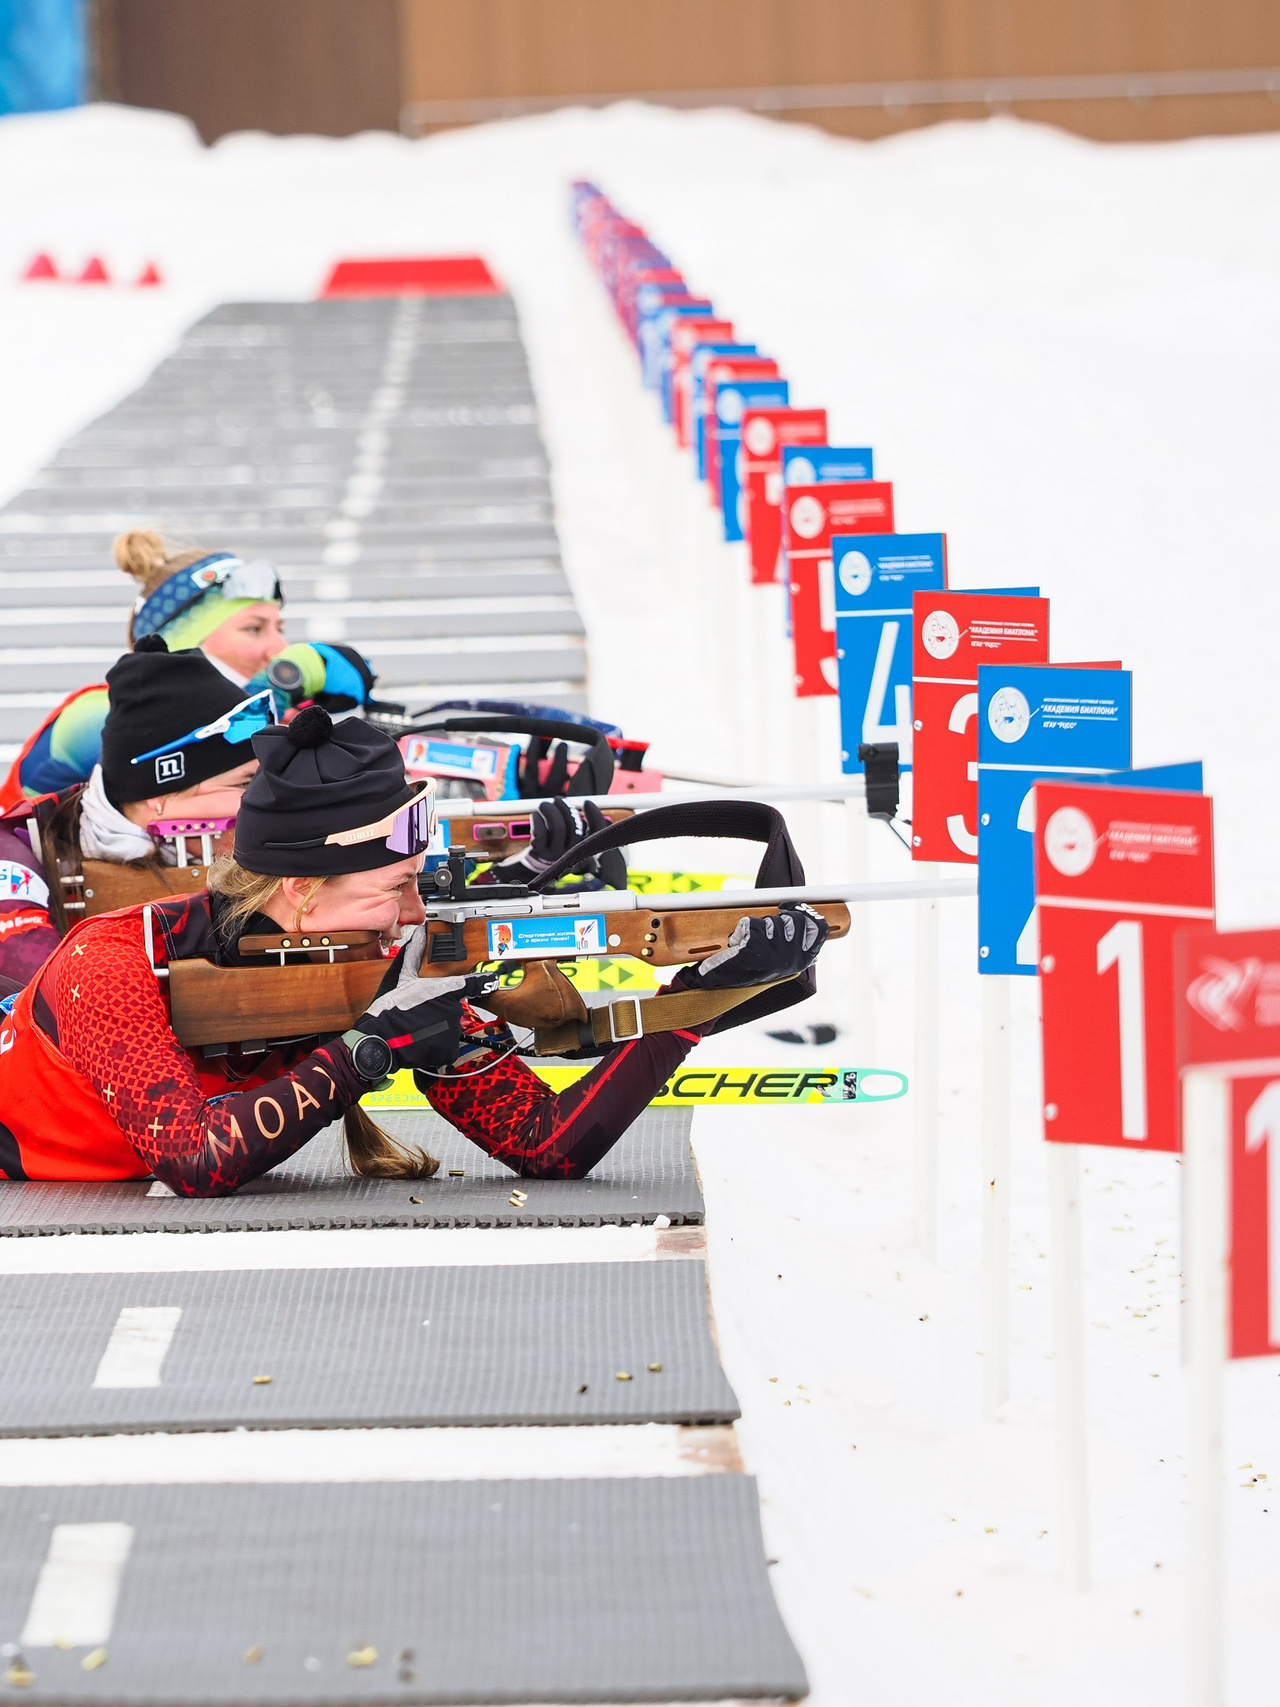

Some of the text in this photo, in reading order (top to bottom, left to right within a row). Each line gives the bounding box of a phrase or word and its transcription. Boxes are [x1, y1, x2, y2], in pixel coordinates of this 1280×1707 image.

[862, 621, 913, 765] 4
[1041, 704, 1118, 715] "АКАДЕМИЯ БИАТЛОНА"
[1097, 921, 1148, 1141] 1
